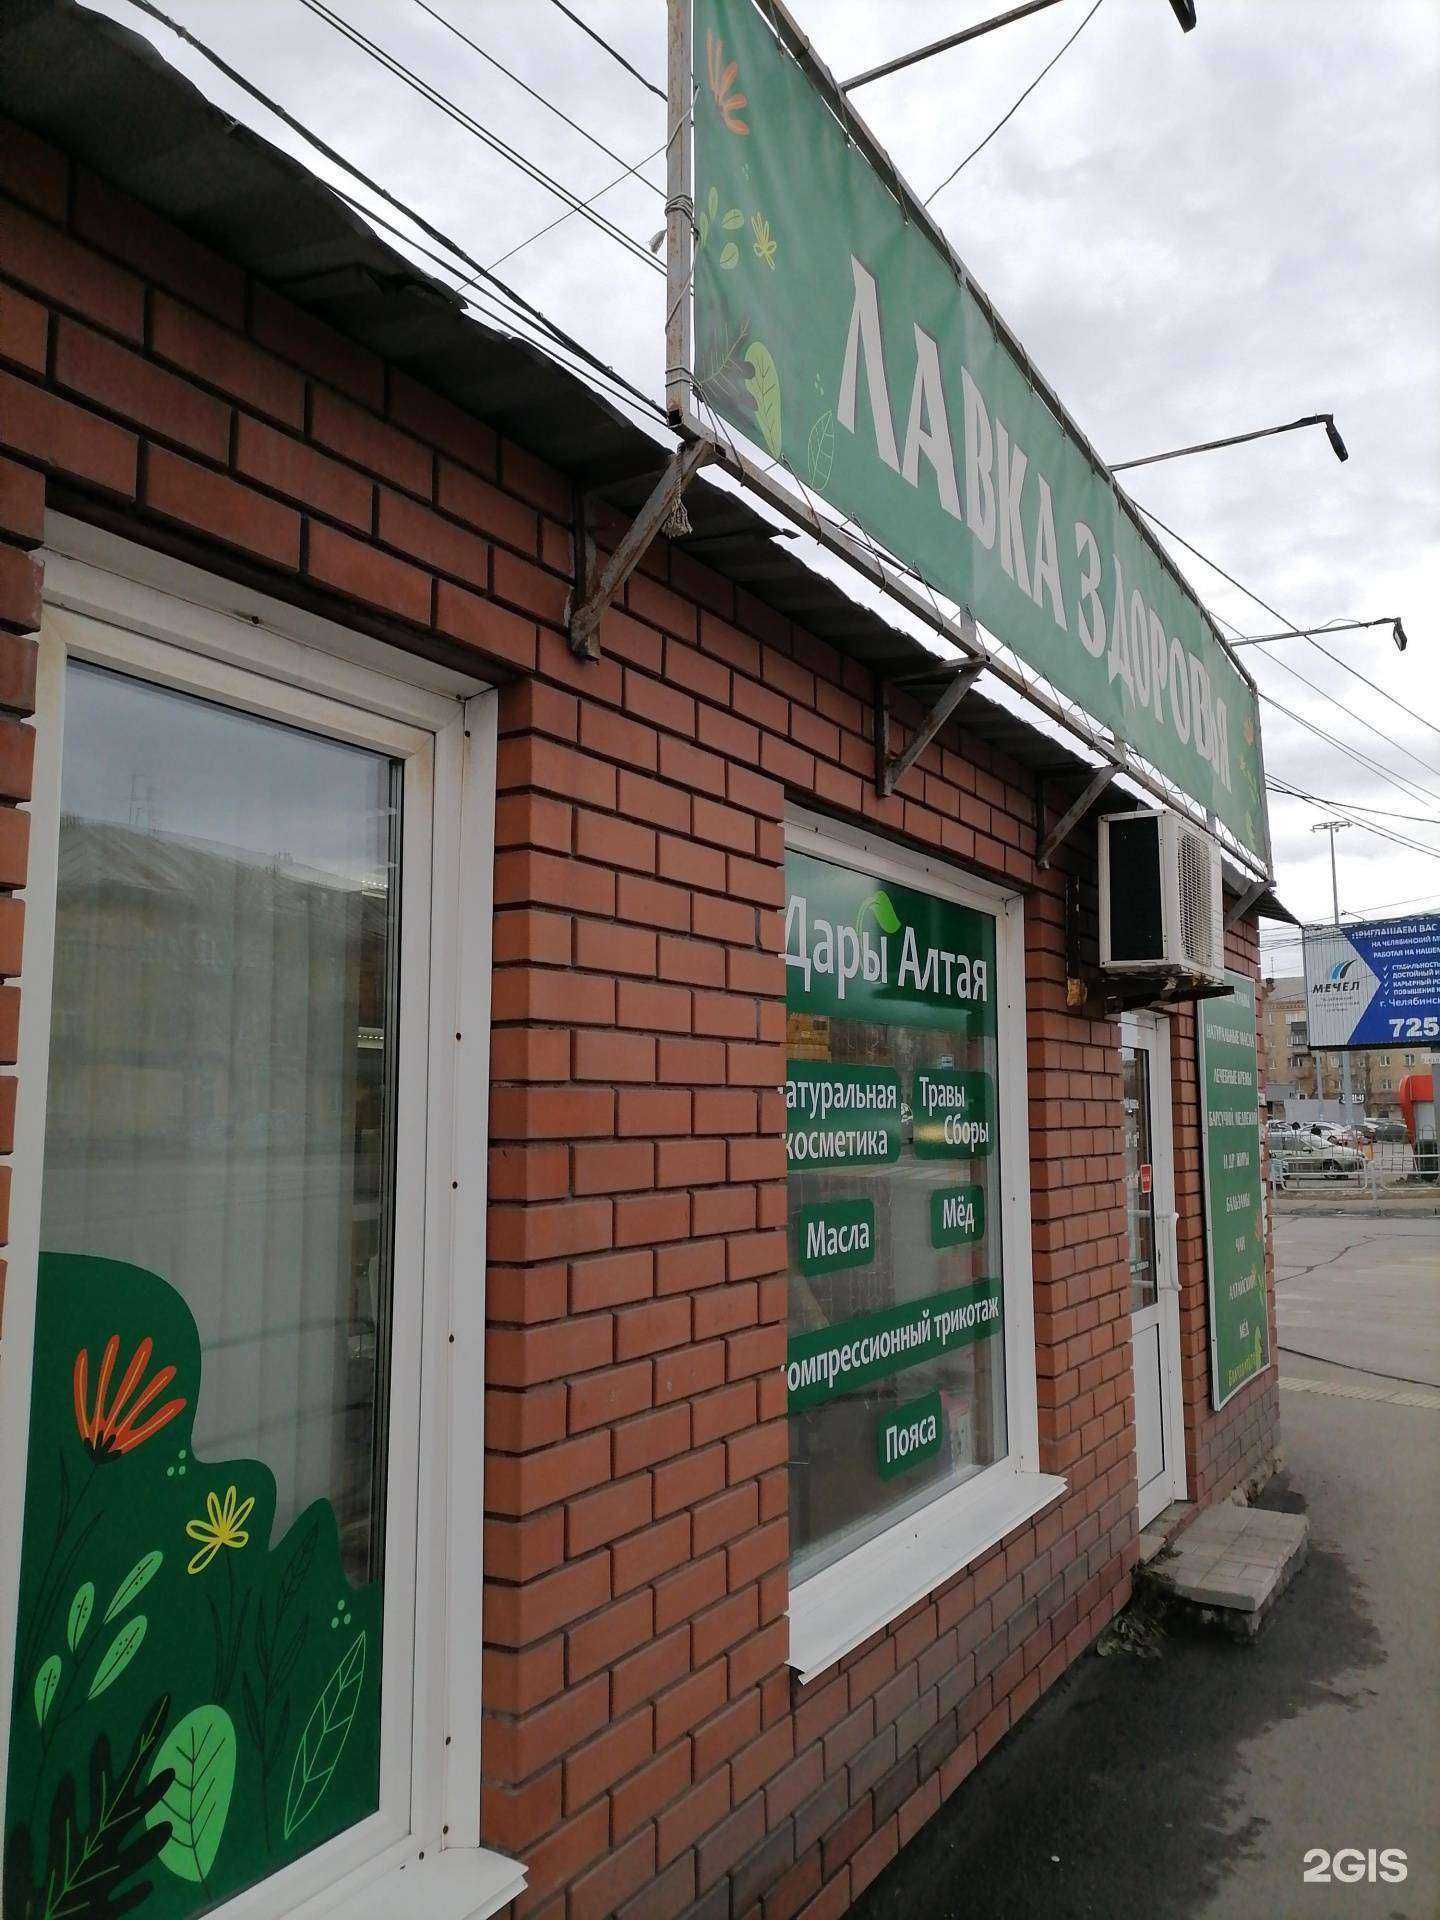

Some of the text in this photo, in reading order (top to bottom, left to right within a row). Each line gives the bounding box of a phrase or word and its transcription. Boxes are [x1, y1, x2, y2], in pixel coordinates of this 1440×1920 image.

[837, 254, 1232, 794] ЛАВКА ЗДОРОВЬЯ
[1420, 924, 1438, 933] ВАС
[778, 895, 988, 1002] Дары Алтая
[1373, 950, 1403, 958] РАБОТАЯ
[1312, 981, 1360, 994] МЕЧЕЛ
[1389, 1016, 1440, 1038] 725
[777, 1080, 897, 1119] атуральная
[919, 1076, 965, 1117] Травы
[943, 1113, 989, 1152] Сборы
[942, 1195, 975, 1235] Мёд
[806, 1220, 870, 1259] Масла
[780, 1296, 999, 1391] омпрессионный трикотаж
[886, 1415, 937, 1464] Пояса
